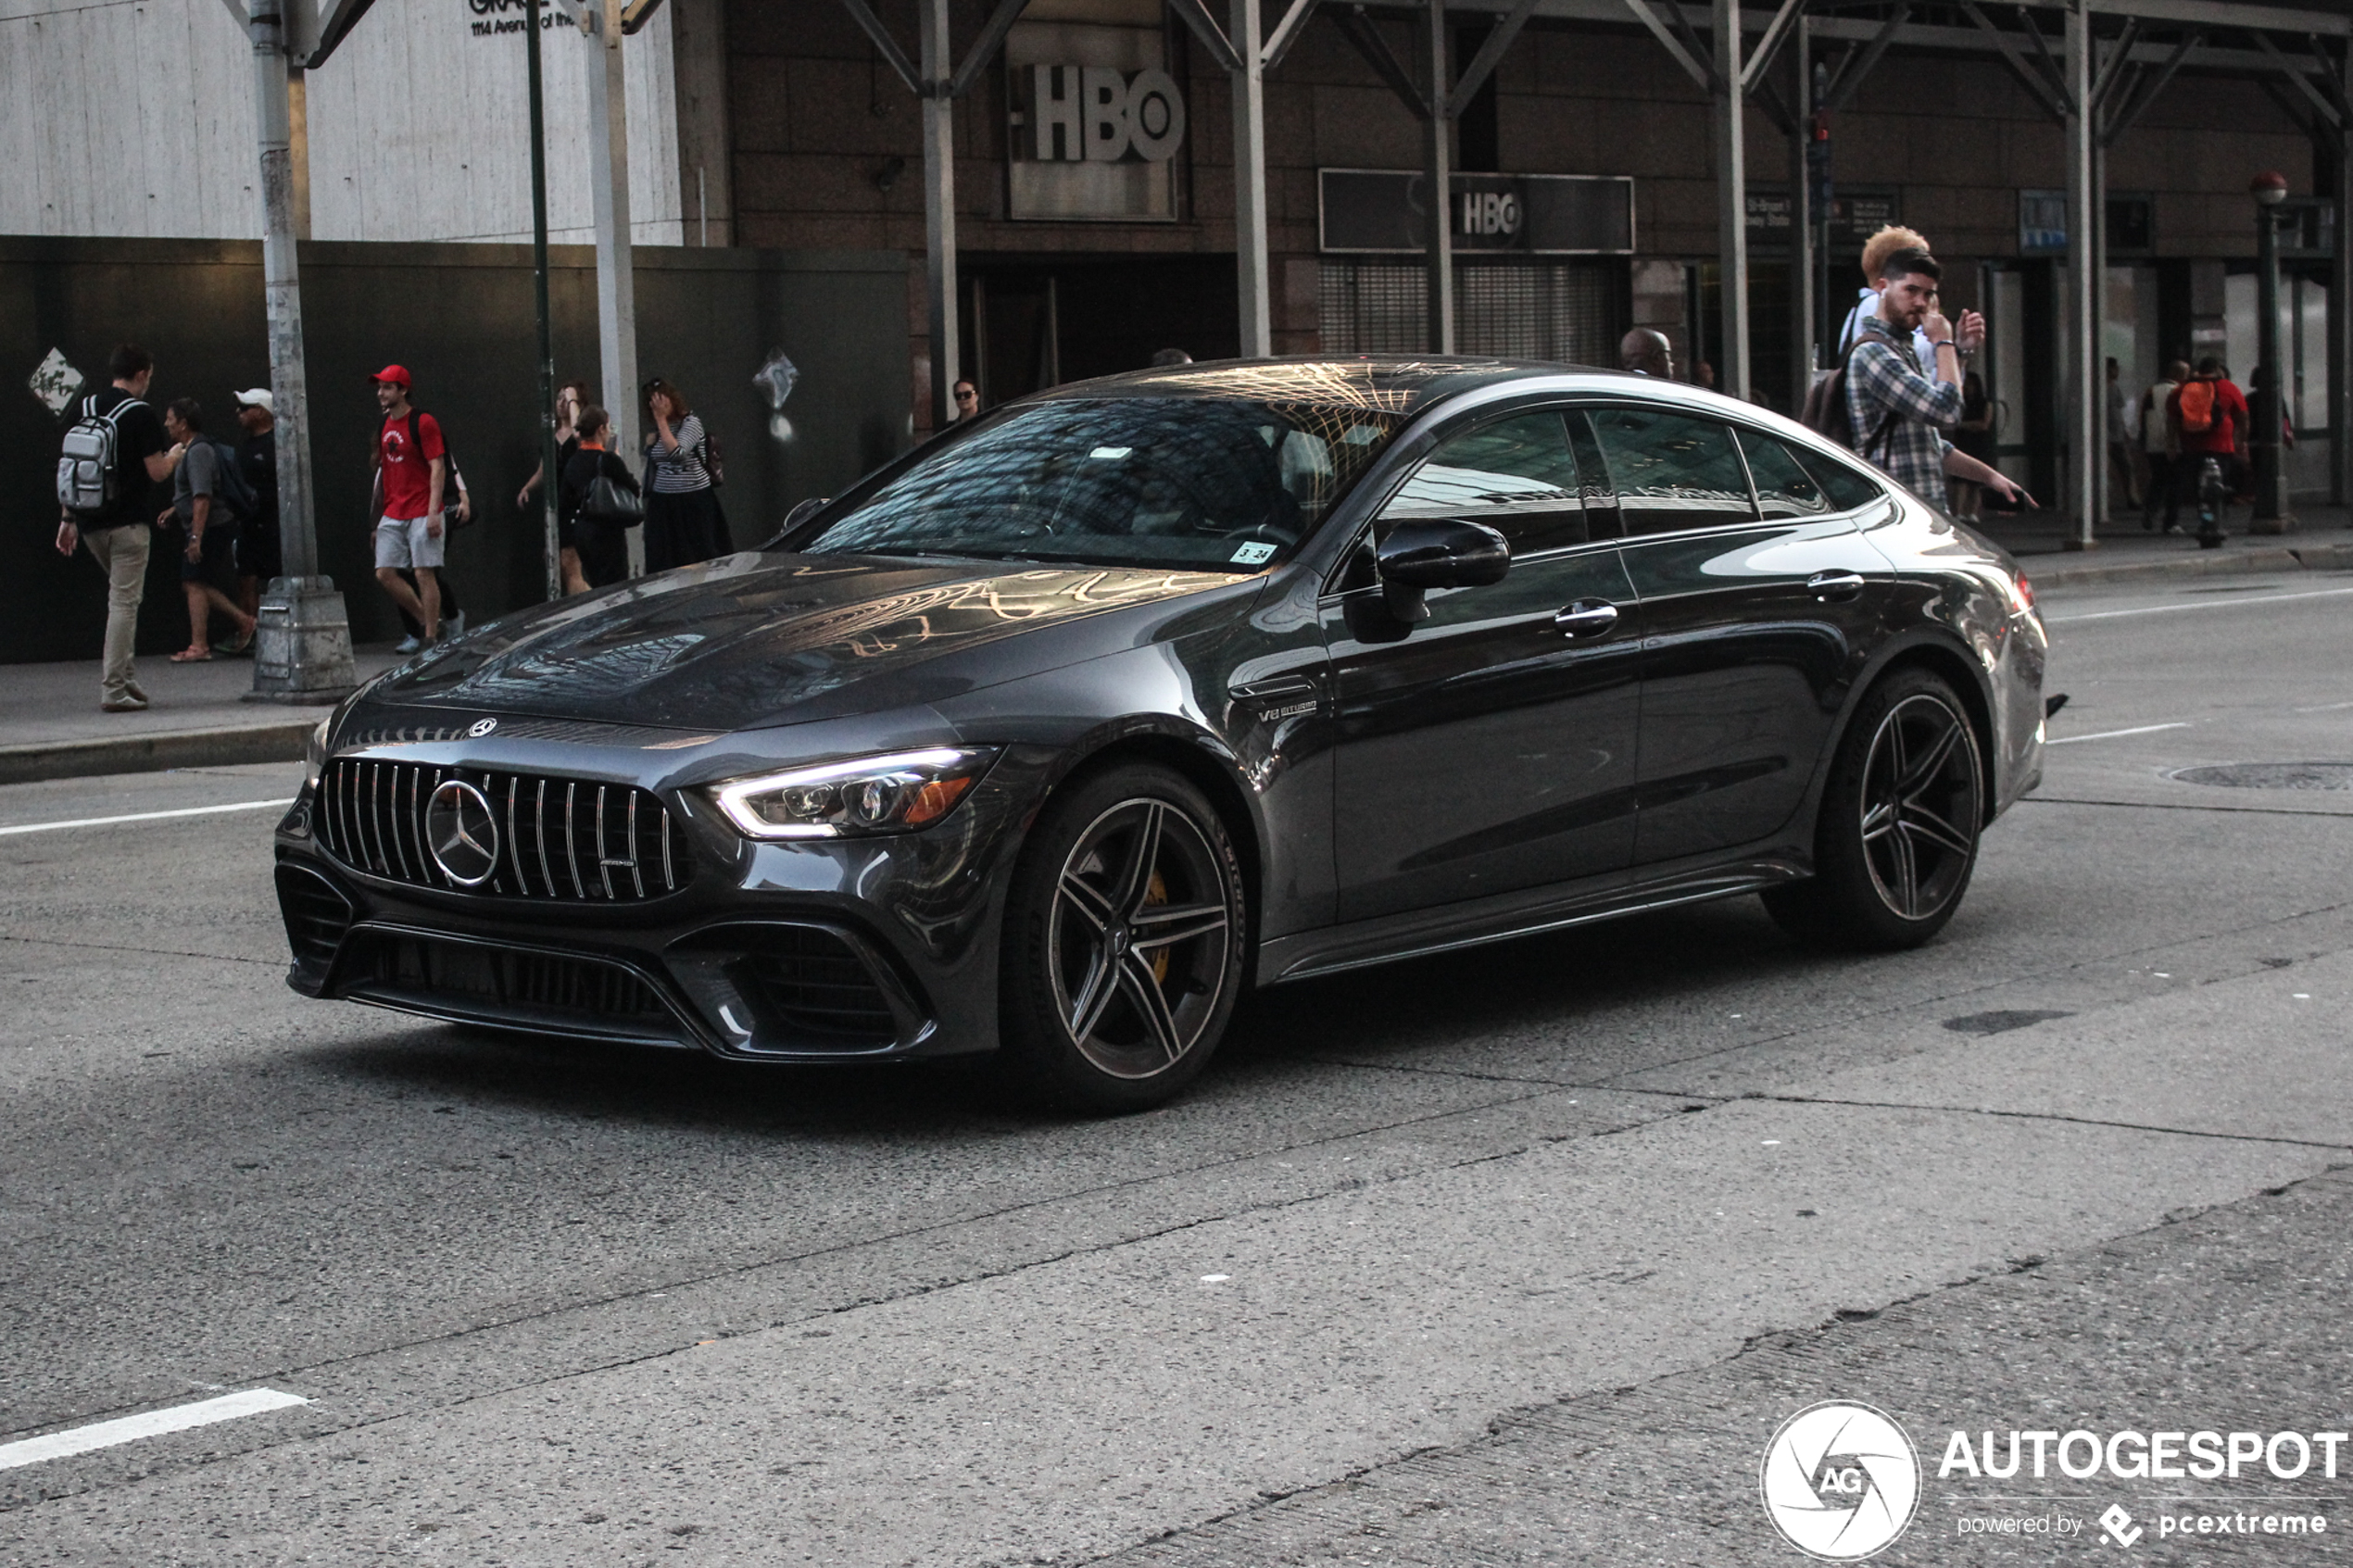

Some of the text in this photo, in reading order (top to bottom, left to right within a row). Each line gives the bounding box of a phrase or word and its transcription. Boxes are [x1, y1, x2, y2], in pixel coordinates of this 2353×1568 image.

[541, 12, 553, 29] of
[1034, 64, 1186, 162] HBO
[1464, 193, 1522, 234] HBO
[1239, 548, 1269, 559] 3 24
[1258, 709, 1279, 722] V8
